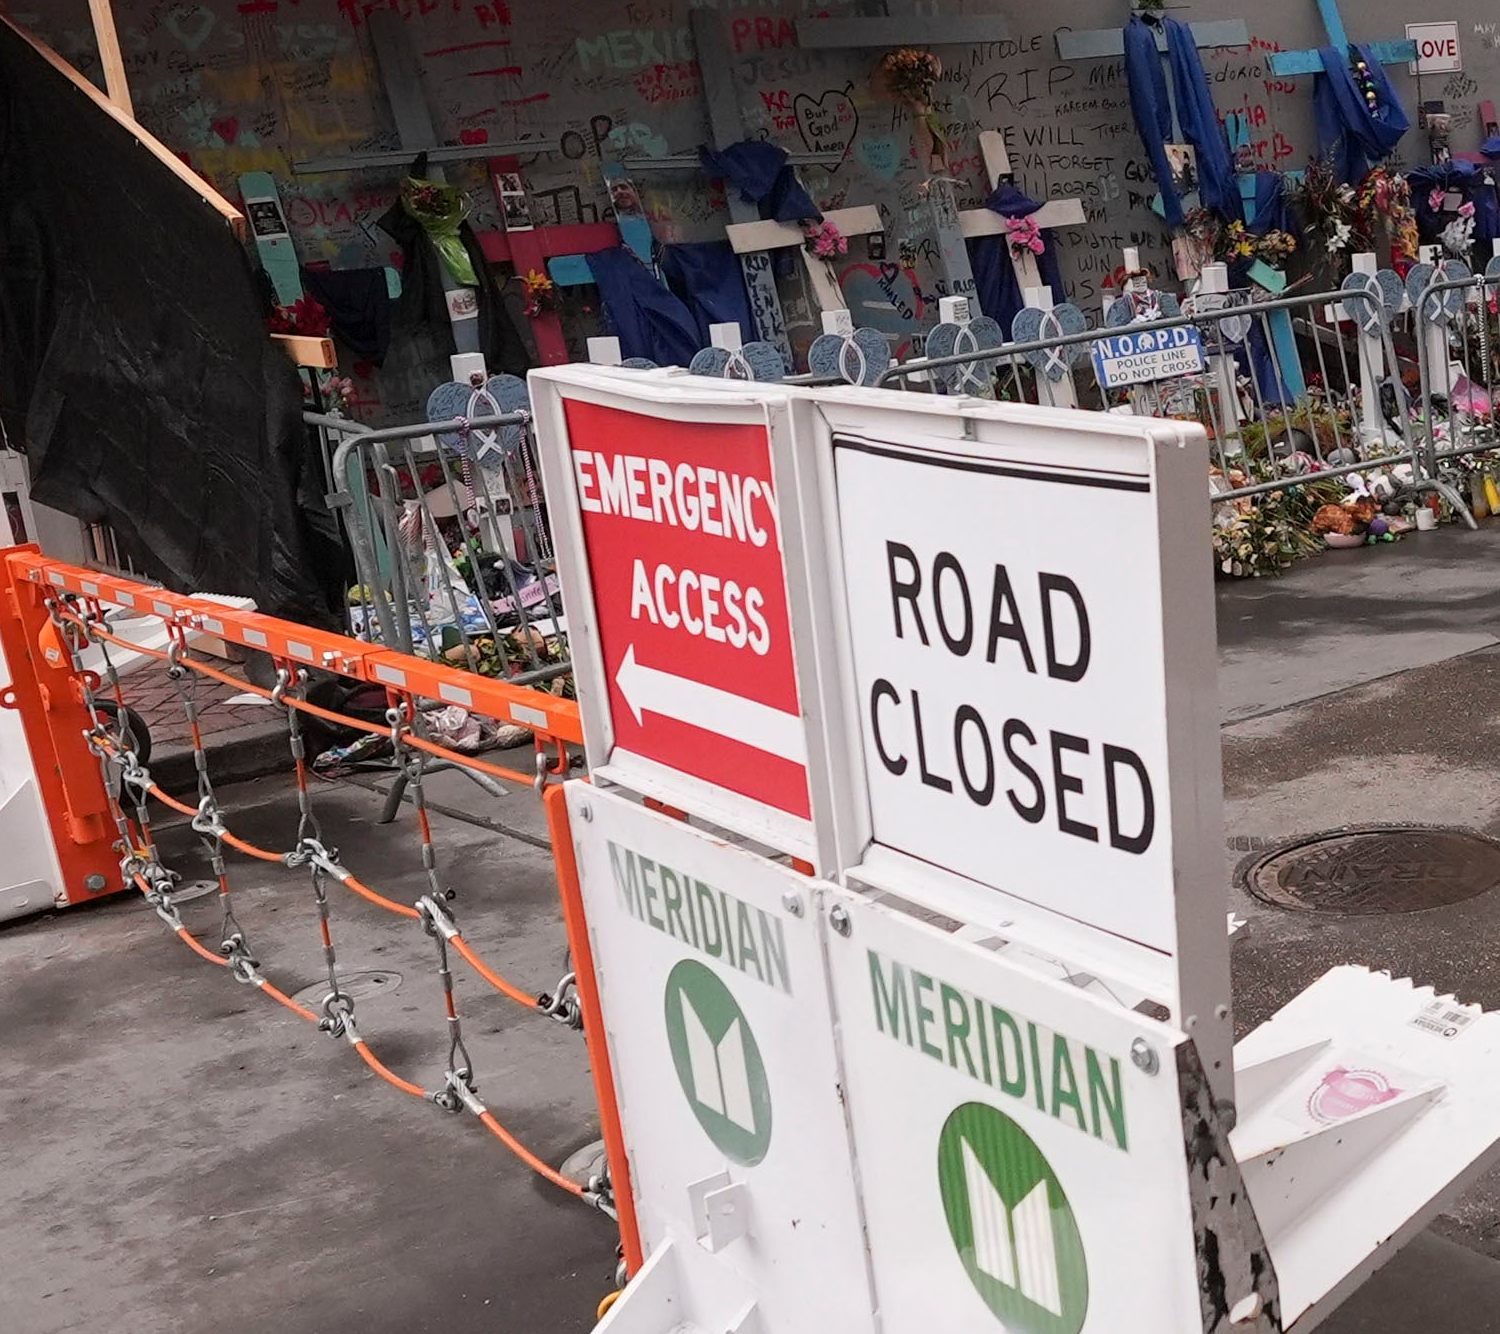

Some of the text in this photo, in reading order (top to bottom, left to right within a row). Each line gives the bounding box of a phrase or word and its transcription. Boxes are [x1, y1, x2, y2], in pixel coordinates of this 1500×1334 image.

[1417, 38, 1457, 59] OVE
[1023, 127, 1085, 147] WILL
[1008, 152, 1044, 169] EVA
[876, 277, 914, 321] KHALED
[1109, 359, 1199, 384] DO NOT CROSS
[1116, 349, 1187, 370] POLICE LINE
[630, 557, 771, 656] ACCESS
[885, 539, 1092, 683] ROAD
[870, 677, 1156, 856] CLOSED
[607, 840, 794, 998] MERIDIAN
[866, 948, 1130, 1154] MERIDIAN
